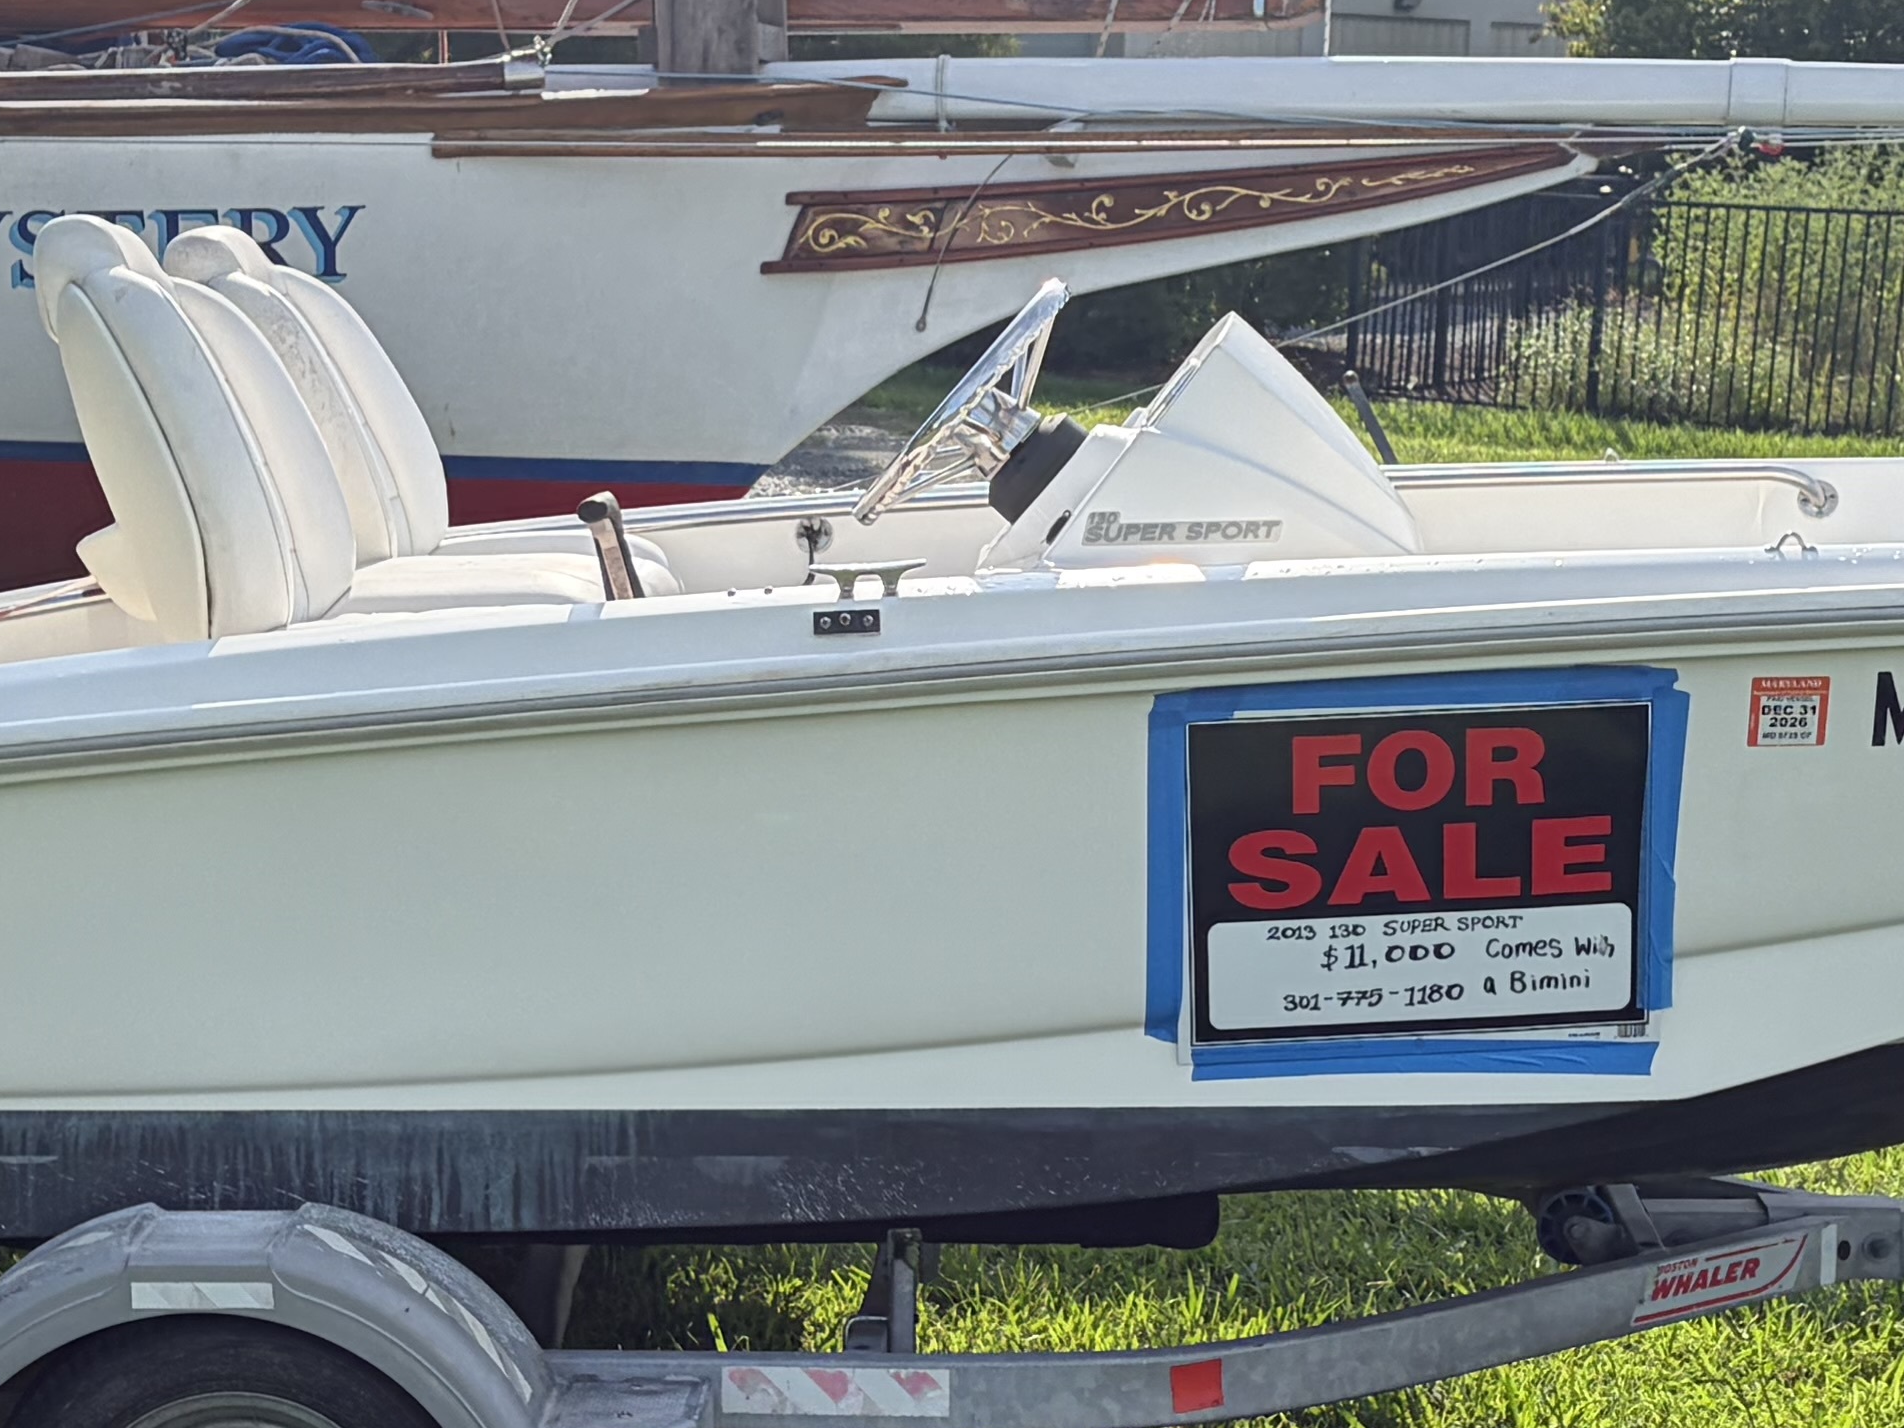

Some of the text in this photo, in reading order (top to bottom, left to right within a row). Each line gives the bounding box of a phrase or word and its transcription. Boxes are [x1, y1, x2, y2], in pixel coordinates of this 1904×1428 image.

[1084, 521, 1281, 543] SUPER SPORT
[1087, 511, 1118, 524] 130
[1761, 704, 1816, 716] DEC 31
[1768, 717, 1808, 728] 2026
[1291, 726, 1546, 814] FOR
[1227, 815, 1612, 910] SALE
[1265, 925, 1317, 941] 2013
[1382, 917, 1452, 936] SUPER
[1457, 914, 1524, 932] SPORT
[1320, 942, 1456, 971] $11,000
[1485, 937, 1563, 959] Comes
[1283, 969, 1591, 1012] 301-775-1180 a Bimini
[1651, 1257, 1761, 1302] WHALER
